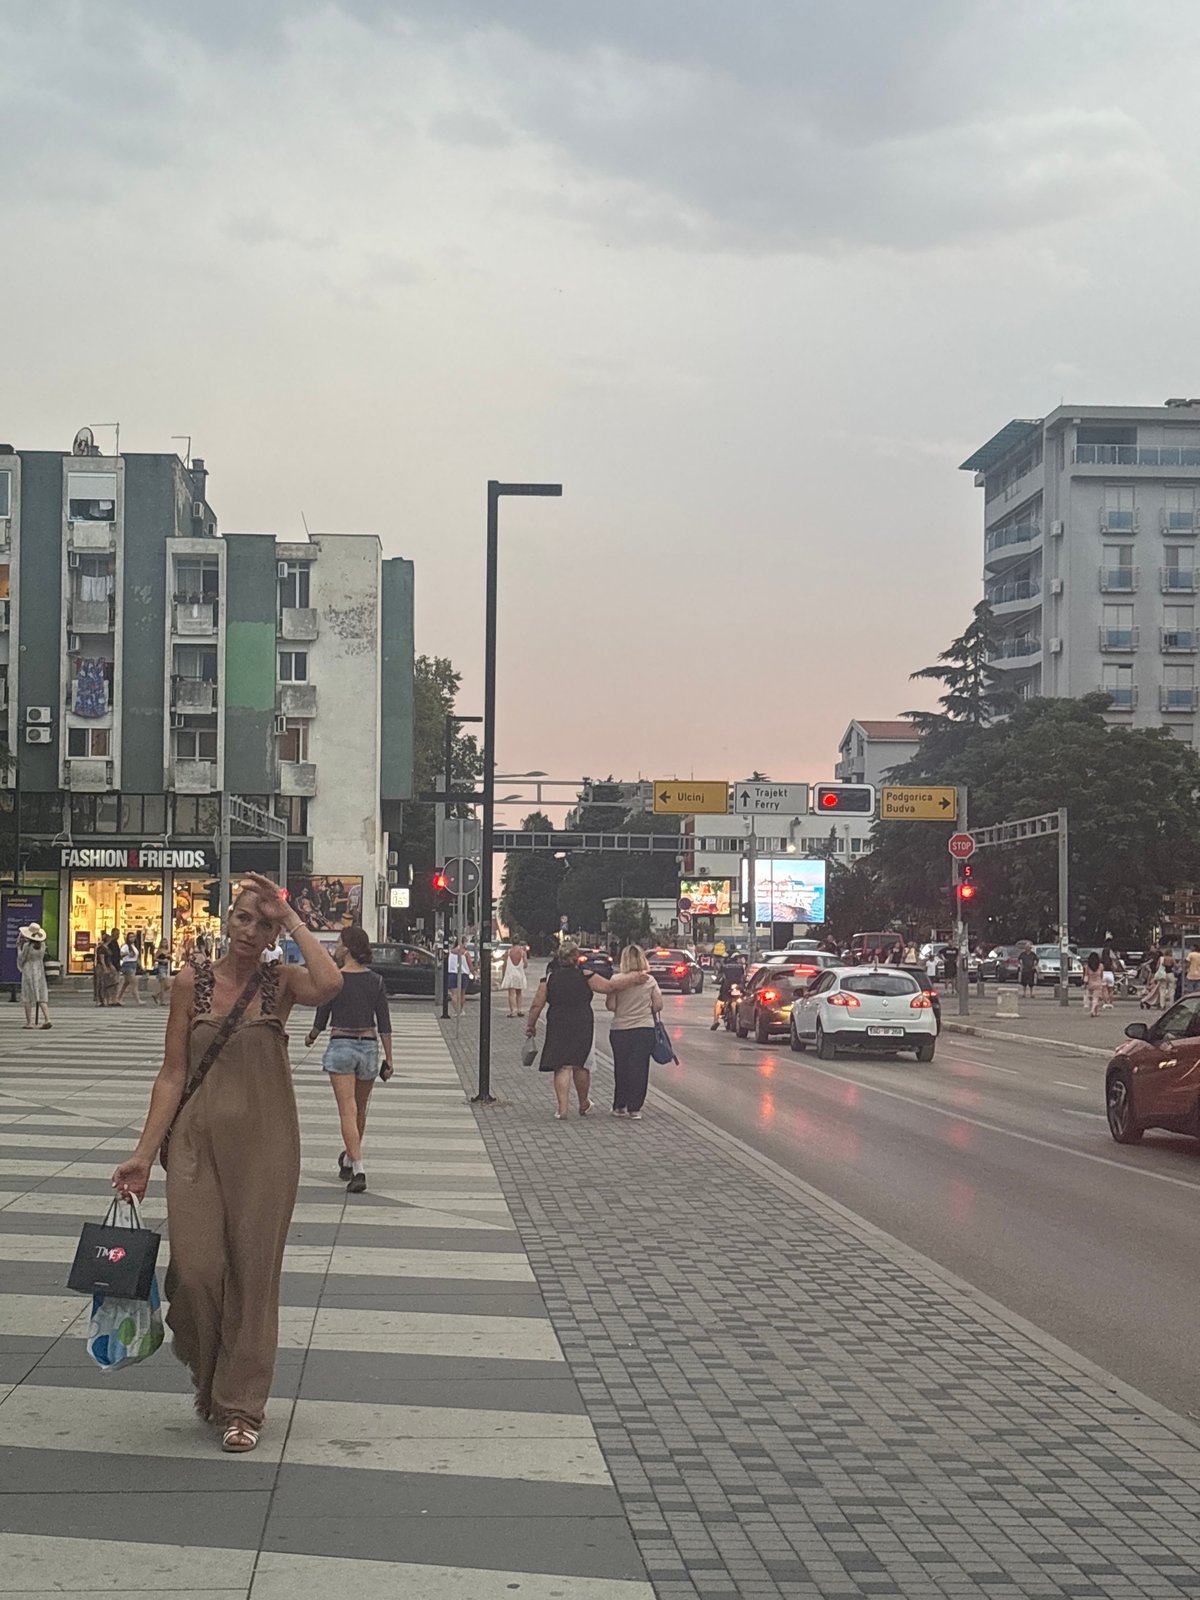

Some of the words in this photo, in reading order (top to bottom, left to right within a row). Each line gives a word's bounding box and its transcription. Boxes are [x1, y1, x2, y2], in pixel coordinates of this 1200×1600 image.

[677, 793, 704, 802] Ulcinj
[755, 788, 788, 798] Trajekt
[886, 792, 933, 803] Podgorica
[755, 800, 780, 811] Ferry
[886, 804, 916, 813] Budva
[952, 841, 972, 851] STOP
